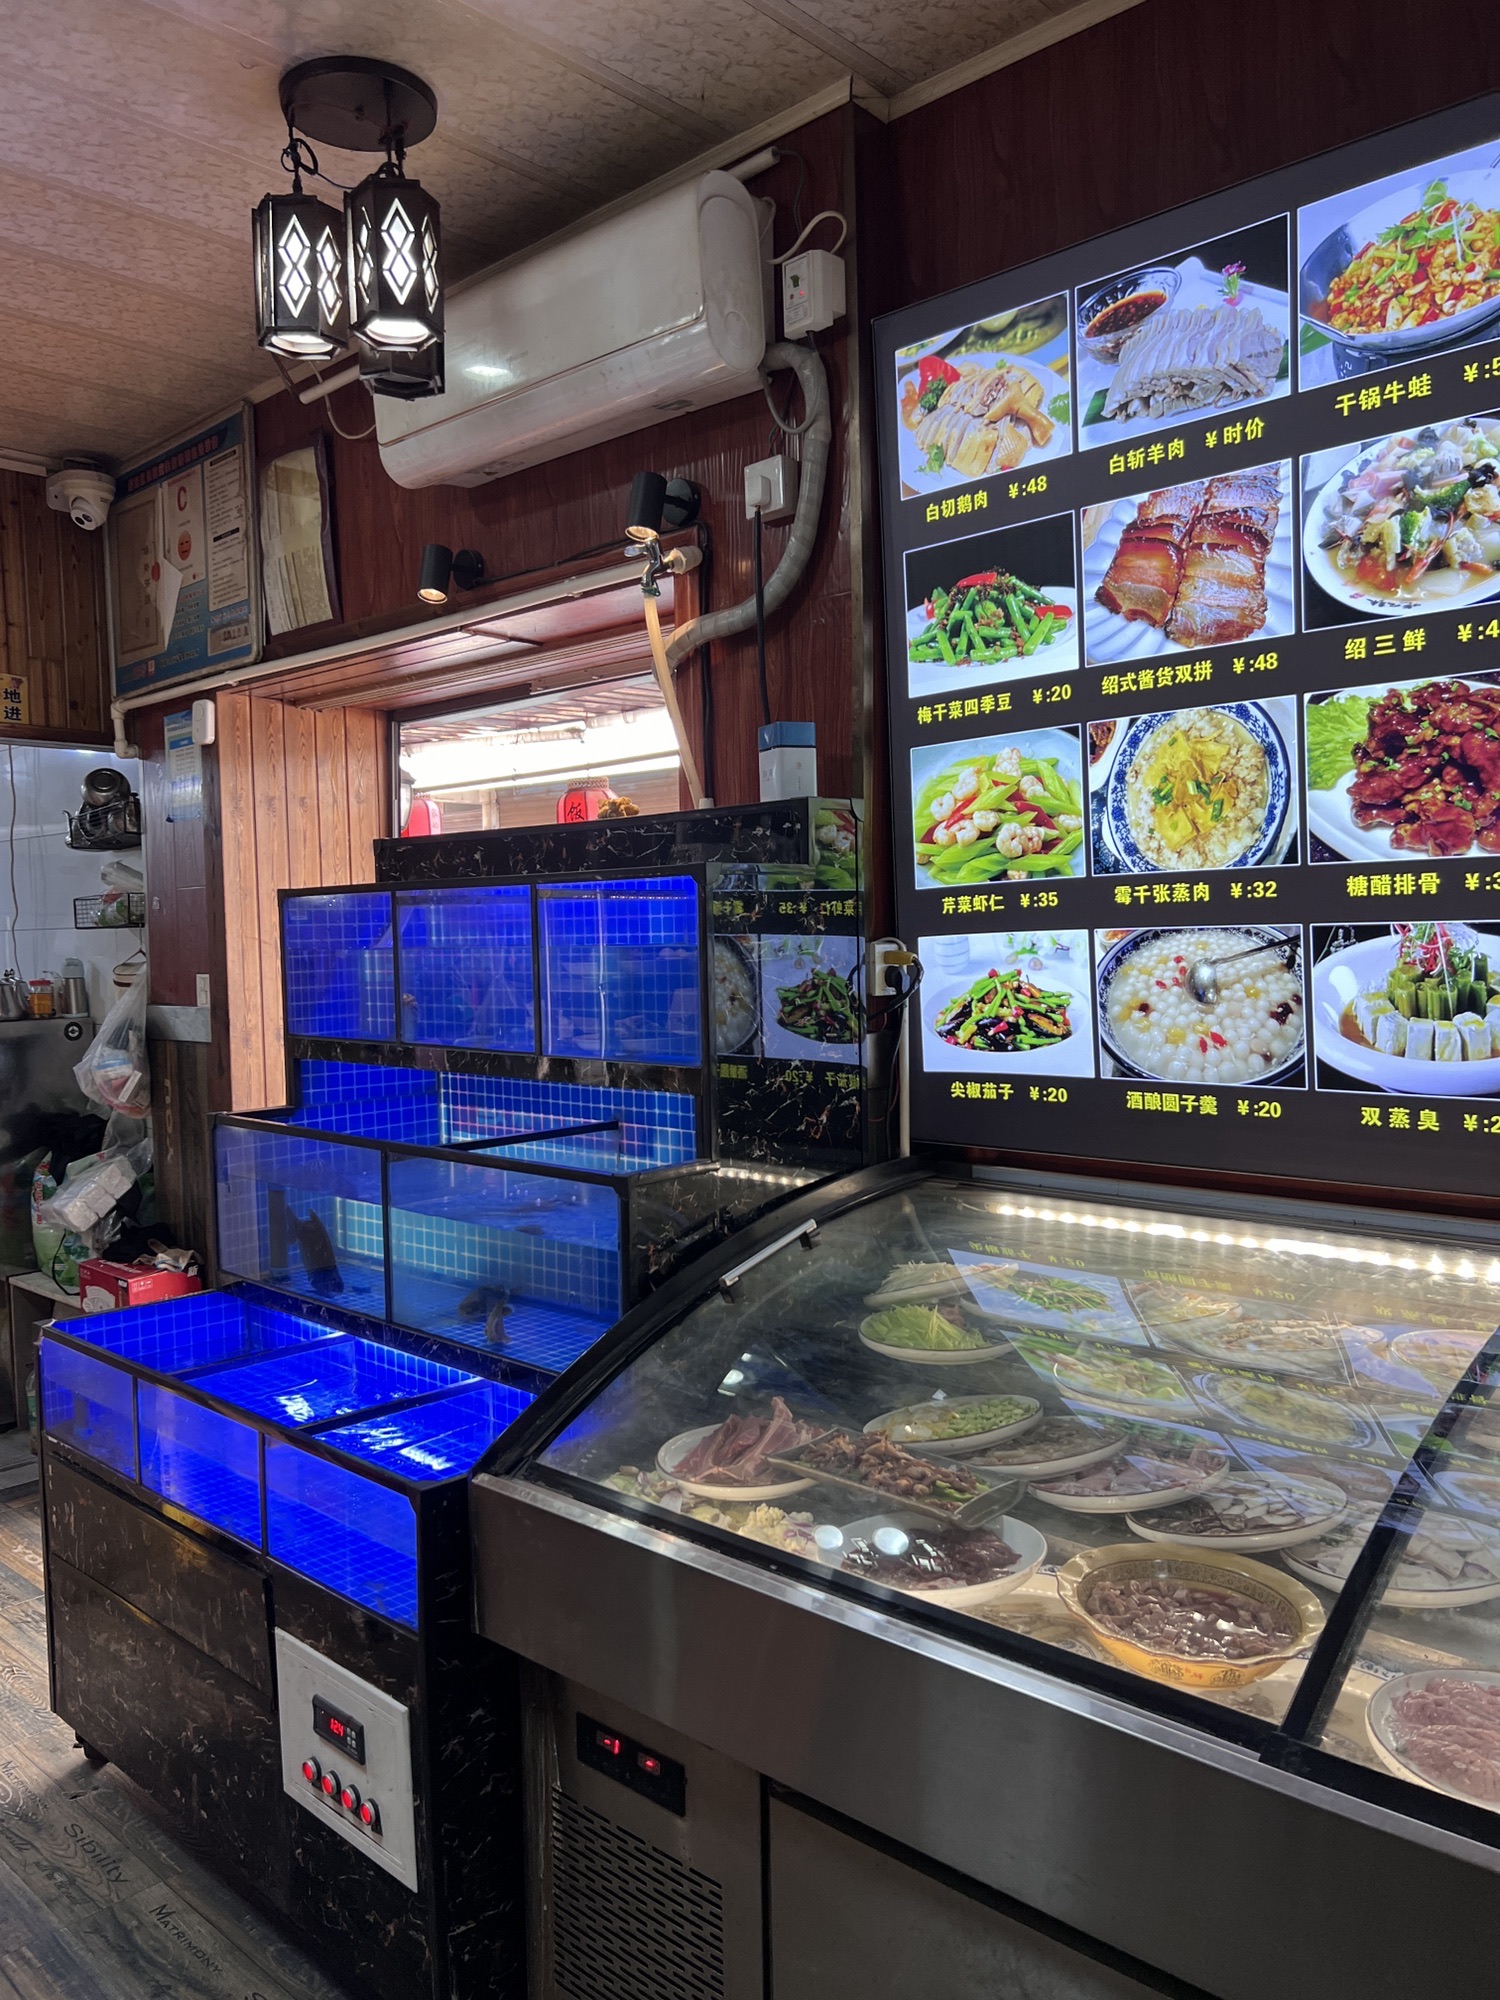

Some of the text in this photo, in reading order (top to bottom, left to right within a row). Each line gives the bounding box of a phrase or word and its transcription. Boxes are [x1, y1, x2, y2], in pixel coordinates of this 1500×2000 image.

[1334, 373, 1432, 417] 干锅牛蛙
[1109, 439, 1185, 474] 白斩羊肉
[926, 491, 988, 523] 白切鹅肉
[1101, 661, 1213, 695] 绍式酱货双拼
[3, 688, 22, 704] 地
[917, 692, 1011, 724] 梅干菜四季豆
[4, 706, 22, 721] 进
[1114, 882, 1210, 906] 霉千张蒸肉
[1346, 872, 1441, 897] 糖醋排骨
[943, 895, 1003, 915] 芹菜虾仁
[951, 1082, 1013, 1101] 尖椒茄子
[1126, 1091, 1217, 1116] 酒酿圆子羹
[149, 1903, 222, 1974] MATRIMONY
